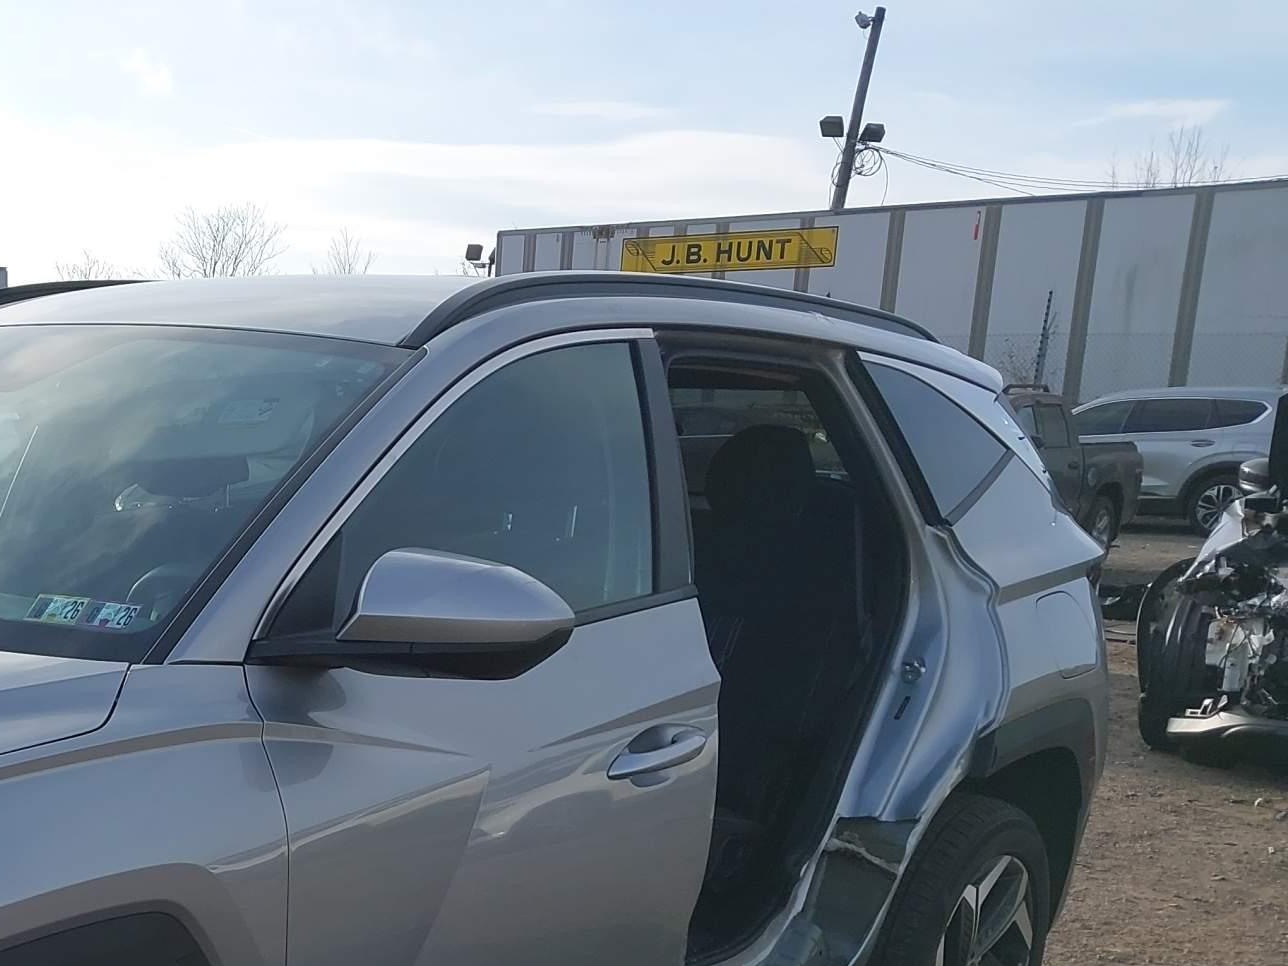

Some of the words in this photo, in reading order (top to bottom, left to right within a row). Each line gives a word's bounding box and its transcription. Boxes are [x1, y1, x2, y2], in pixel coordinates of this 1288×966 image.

[661, 244, 708, 265] J.B.
[715, 238, 793, 263] HUNT
[63, 600, 85, 620] 26
[116, 606, 138, 626] 26
